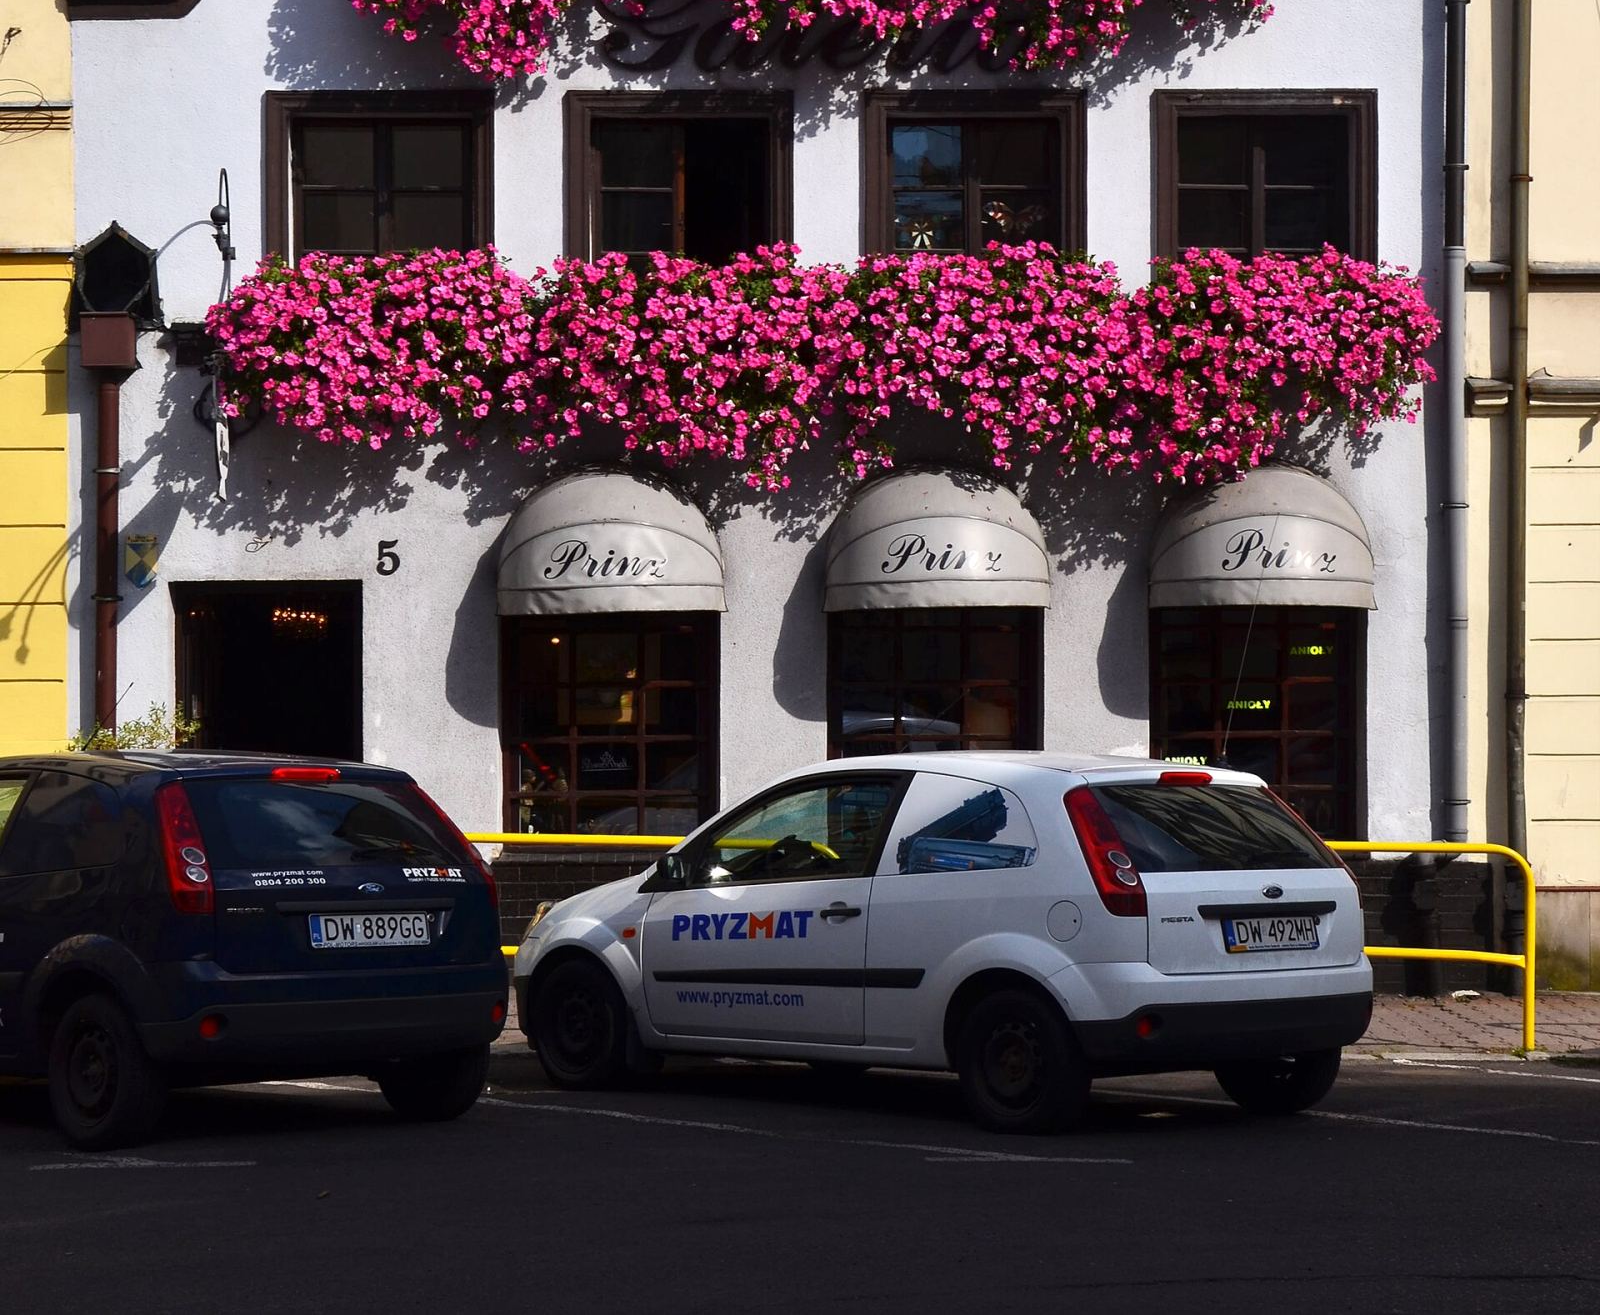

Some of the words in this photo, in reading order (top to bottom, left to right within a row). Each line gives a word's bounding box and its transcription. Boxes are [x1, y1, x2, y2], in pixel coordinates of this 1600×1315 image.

[376, 539, 401, 576] 5
[544, 539, 665, 579] Prinz
[881, 533, 1002, 573] Prinz
[1221, 528, 1337, 573] Prinz
[1226, 699, 1271, 710] ANIOŁY
[254, 878, 282, 886] 0804
[306, 877, 327, 885] 300
[402, 867, 464, 878] PRYZMAT
[324, 917, 355, 941] DW
[362, 916, 425, 940] 889GG
[672, 910, 814, 941] PRYZMAT
[1235, 918, 1263, 943] DW
[1268, 916, 1315, 942] 492MH
[677, 989, 805, 1008] www.pryzmat.com
